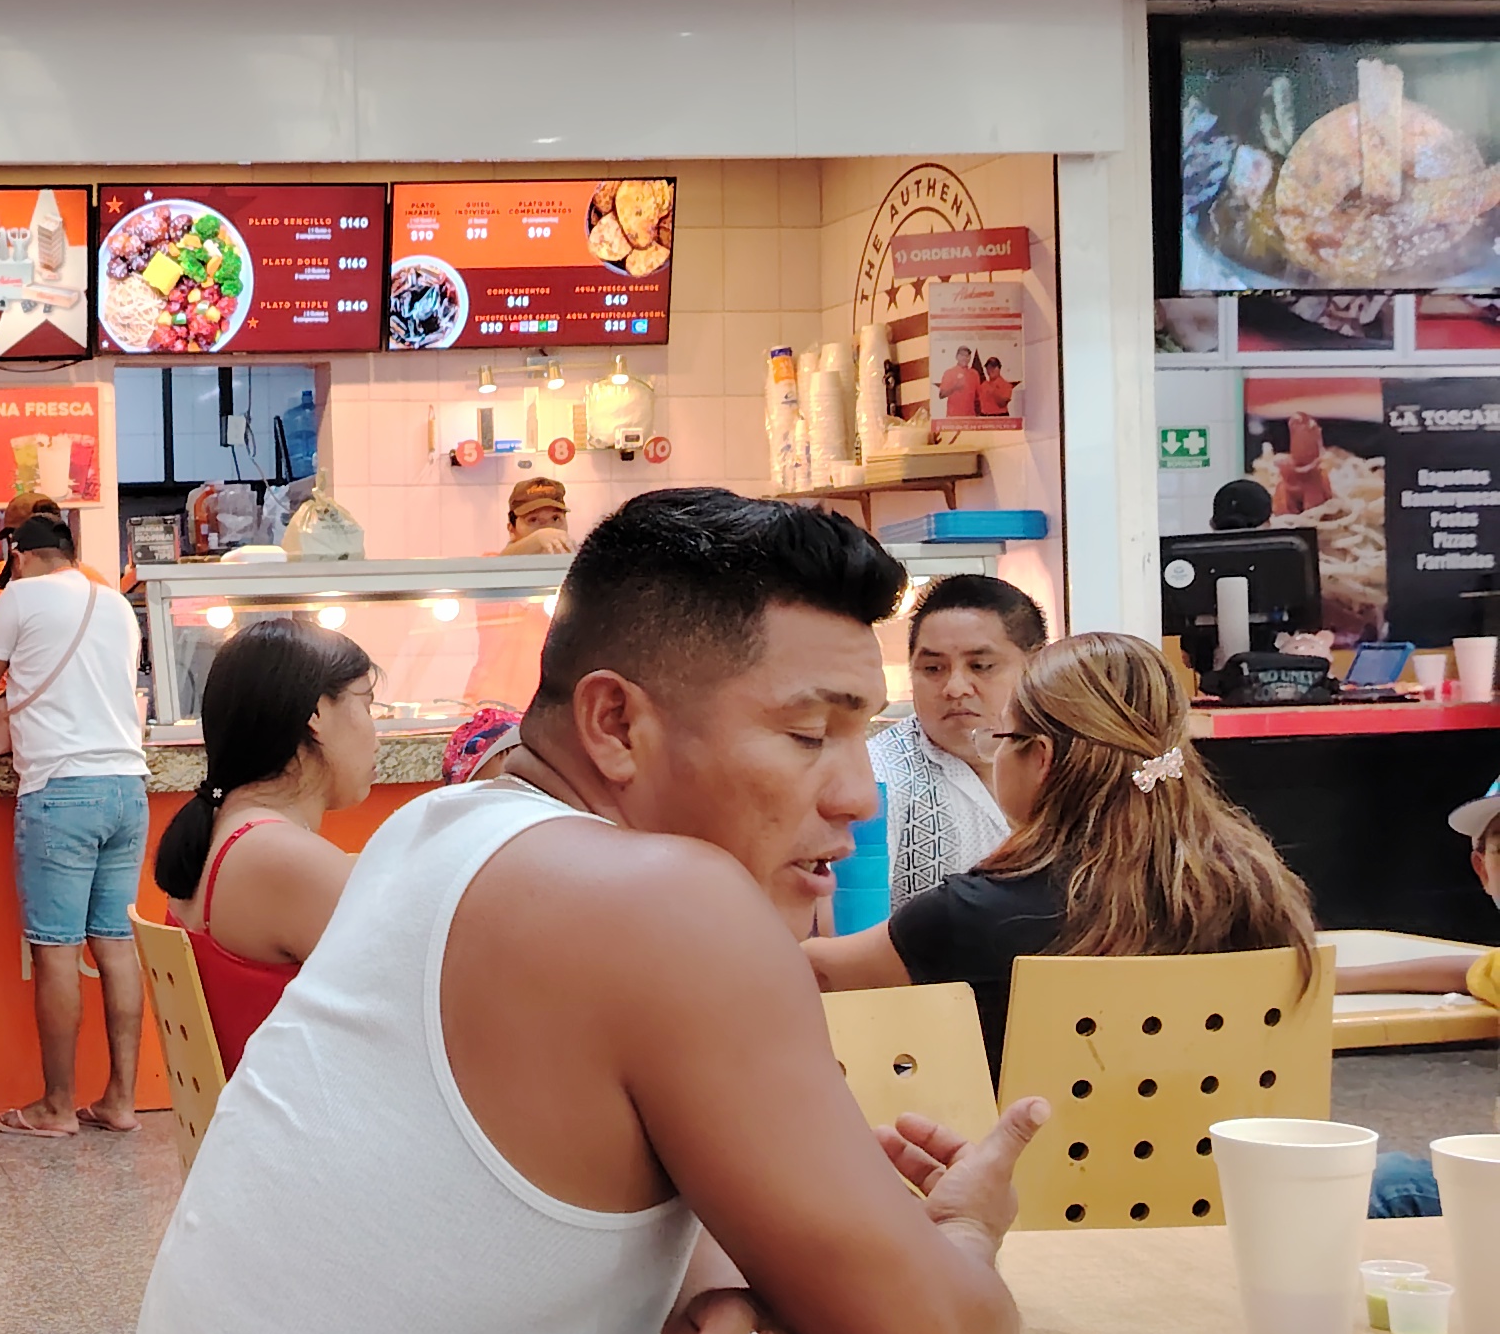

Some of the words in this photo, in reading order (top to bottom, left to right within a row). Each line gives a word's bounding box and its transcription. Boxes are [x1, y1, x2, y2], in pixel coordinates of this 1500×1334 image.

[248, 217, 280, 226] PLATO
[283, 217, 332, 226] SENCILLO
[339, 216, 369, 229] $140
[910, 245, 972, 262] ORDENA
[976, 240, 1011, 257] AQUÍ
[262, 257, 293, 266] PLATO
[297, 257, 329, 266] DOBLE
[860, 233, 883, 305] THE
[260, 301, 291, 309] PLATO
[295, 301, 329, 309] TRIPLE
[25, 401, 94, 417] FRESCA
[1389, 411, 1418, 427] LA
[463, 443, 478, 462] 5
[554, 440, 569, 460] 8
[645, 440, 670, 458] 10
